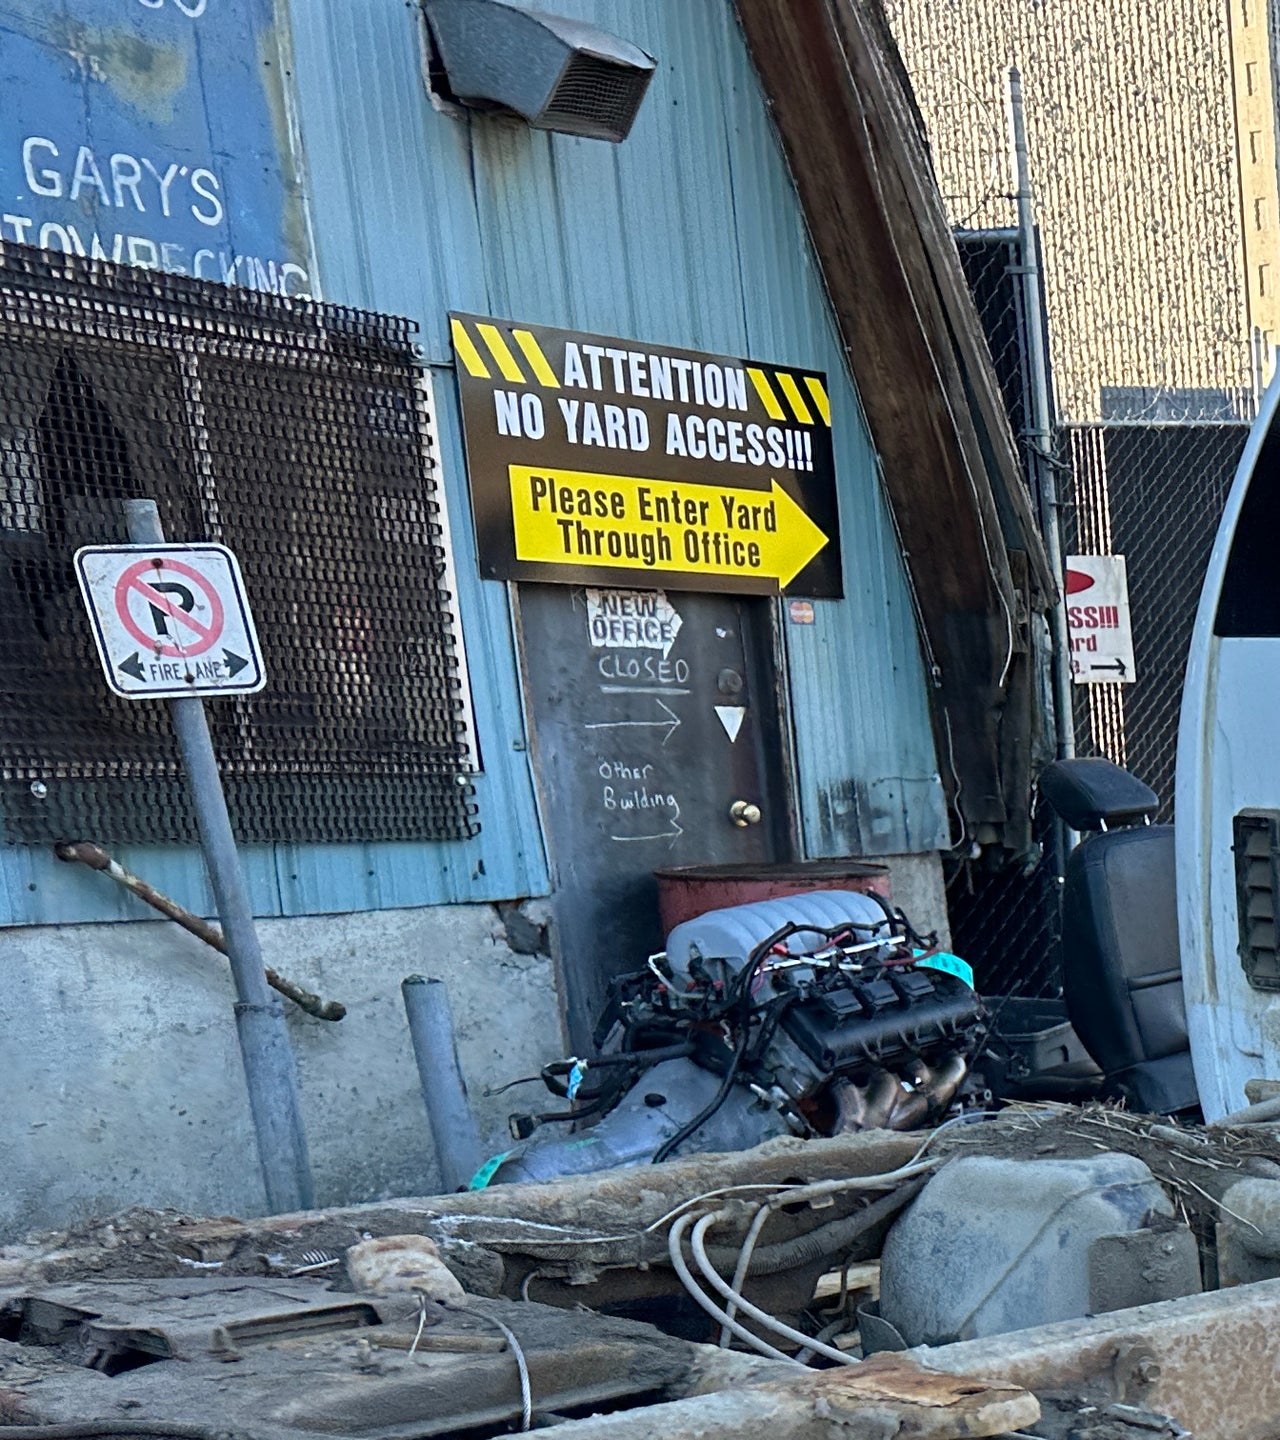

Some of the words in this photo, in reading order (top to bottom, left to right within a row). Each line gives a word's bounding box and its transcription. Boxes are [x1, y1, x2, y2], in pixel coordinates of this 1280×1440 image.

[22, 136, 224, 227] GARY'S
[563, 341, 748, 412] ATTENTION
[493, 389, 545, 440] NO
[558, 398, 650, 453] YARD
[665, 413, 814, 472] ACCESS!!!
[529, 476, 625, 519] Please
[638, 487, 709, 526] Enter
[720, 494, 777, 533] Yard
[556, 518, 672, 567] Through
[685, 528, 761, 568] Office
[601, 596, 657, 617] NEW
[592, 618, 673, 643] OFFICE
[149, 663, 183, 681] FIRE
[599, 655, 689, 683] CLOSED
[599, 761, 654, 780] Other
[603, 786, 681, 820] Building
